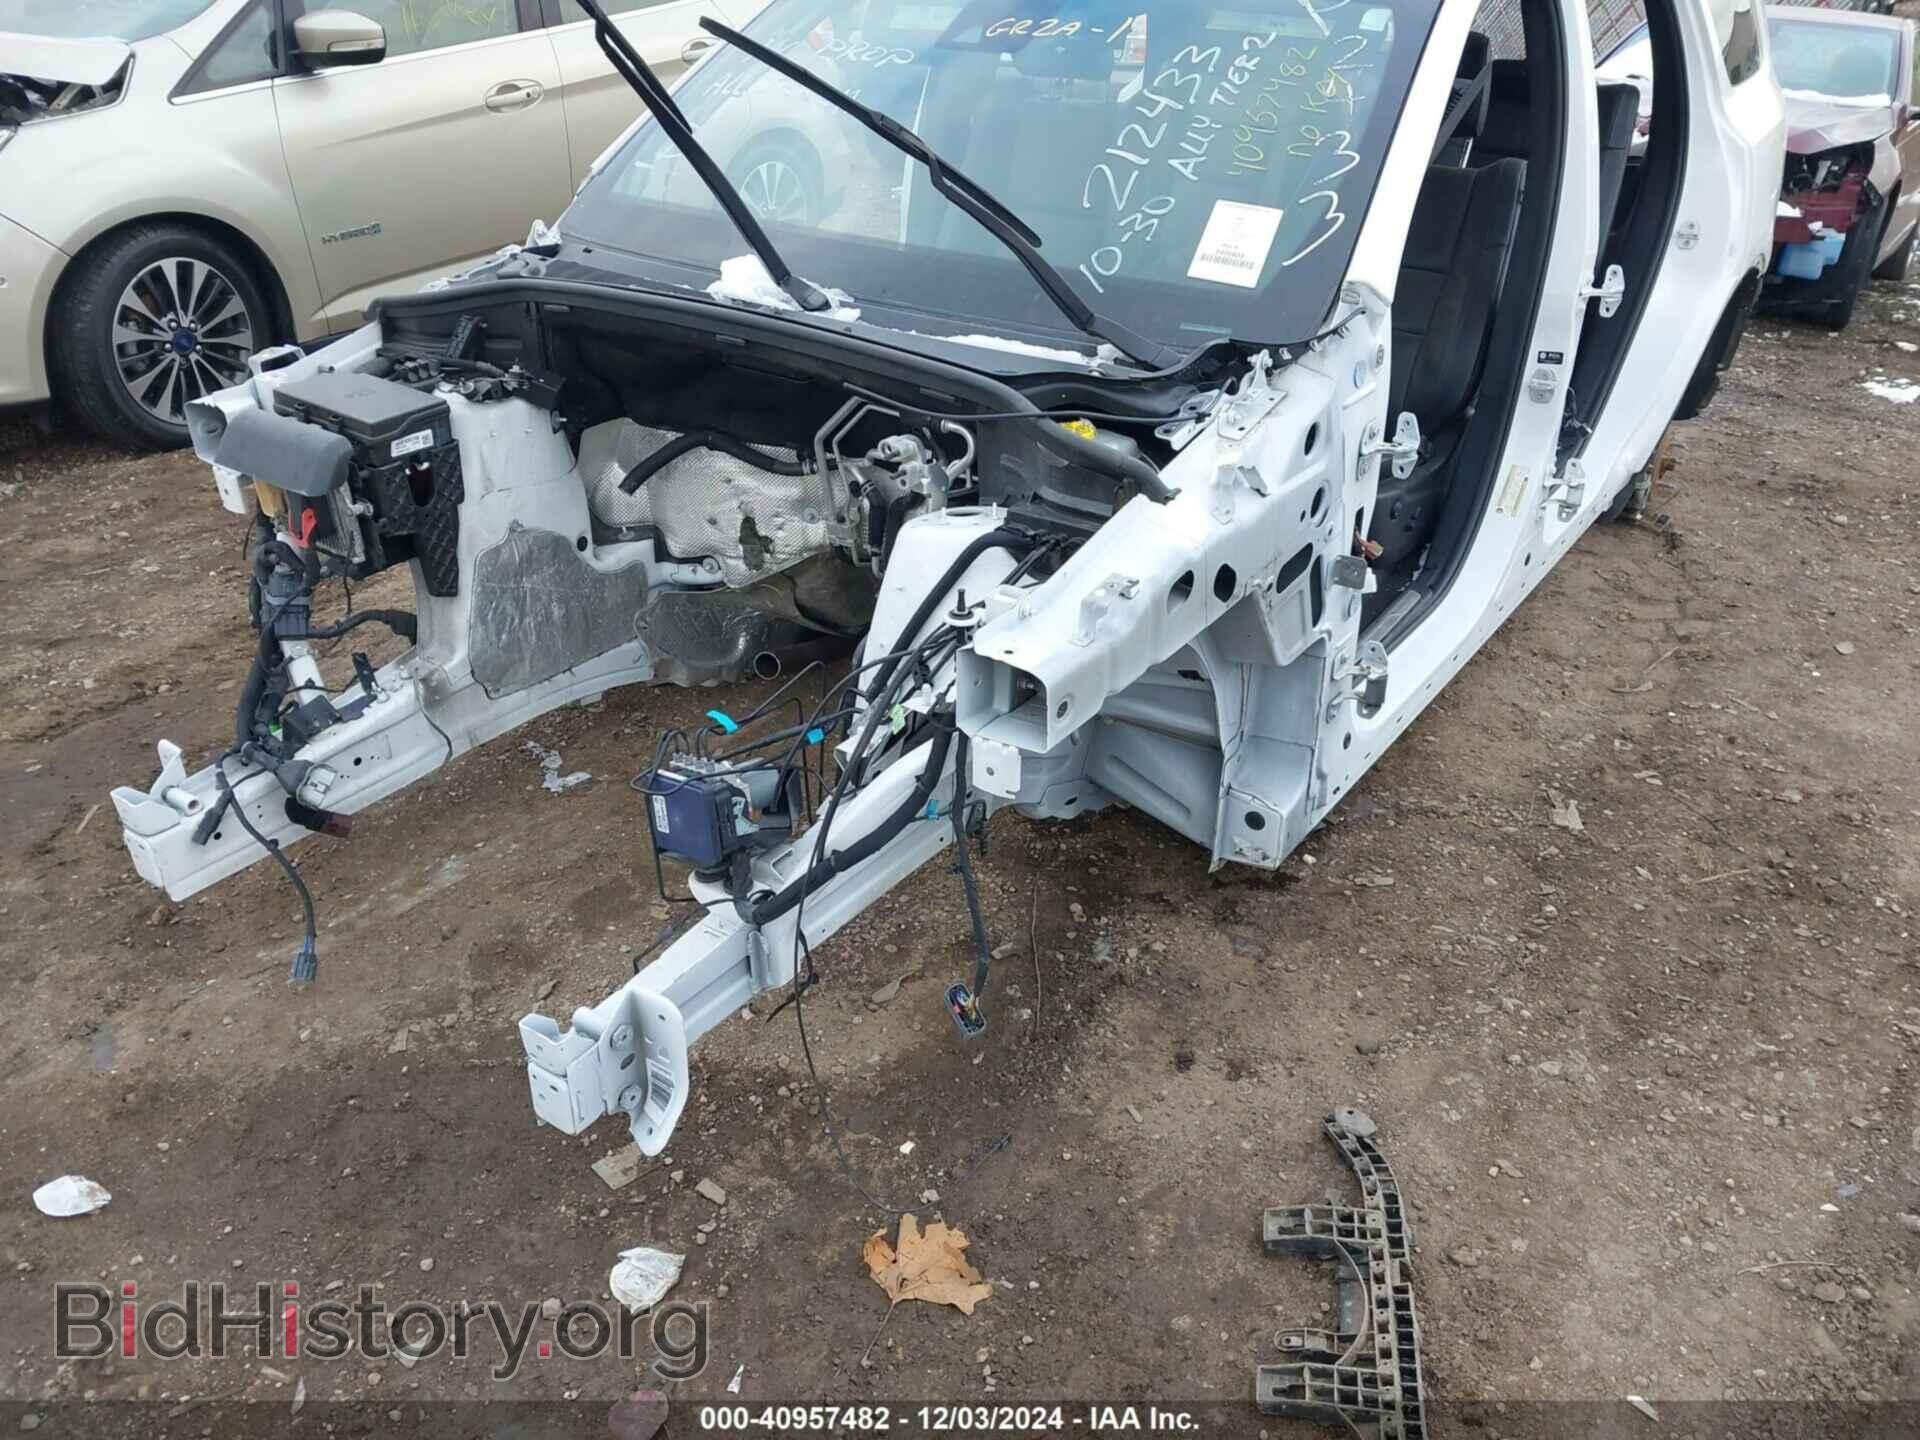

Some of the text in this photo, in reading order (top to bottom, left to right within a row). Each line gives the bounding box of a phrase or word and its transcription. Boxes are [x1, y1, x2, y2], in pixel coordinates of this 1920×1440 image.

[1082, 45, 1222, 211] 212433
[1224, 47, 1319, 177] 40957482
[1080, 196, 1175, 293] 10-30
